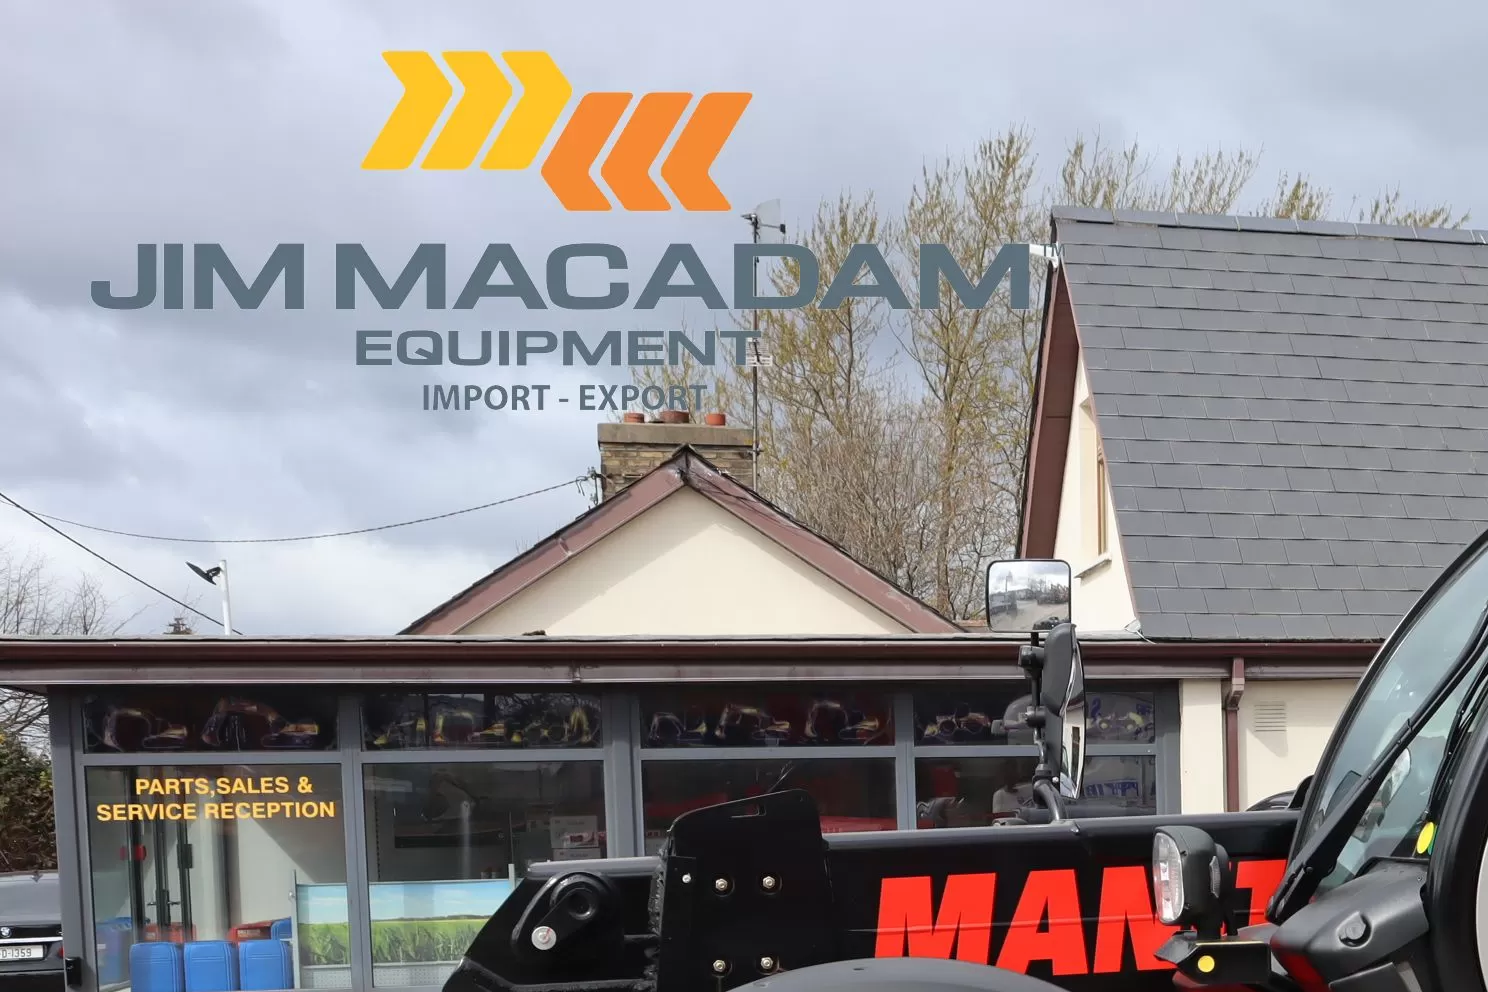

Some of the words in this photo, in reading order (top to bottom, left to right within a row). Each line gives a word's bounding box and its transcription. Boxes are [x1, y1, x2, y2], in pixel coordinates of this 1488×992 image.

[297, 776, 313, 794] &
[97, 803, 197, 821] SERVICE
[204, 801, 335, 820] RECEPTION
